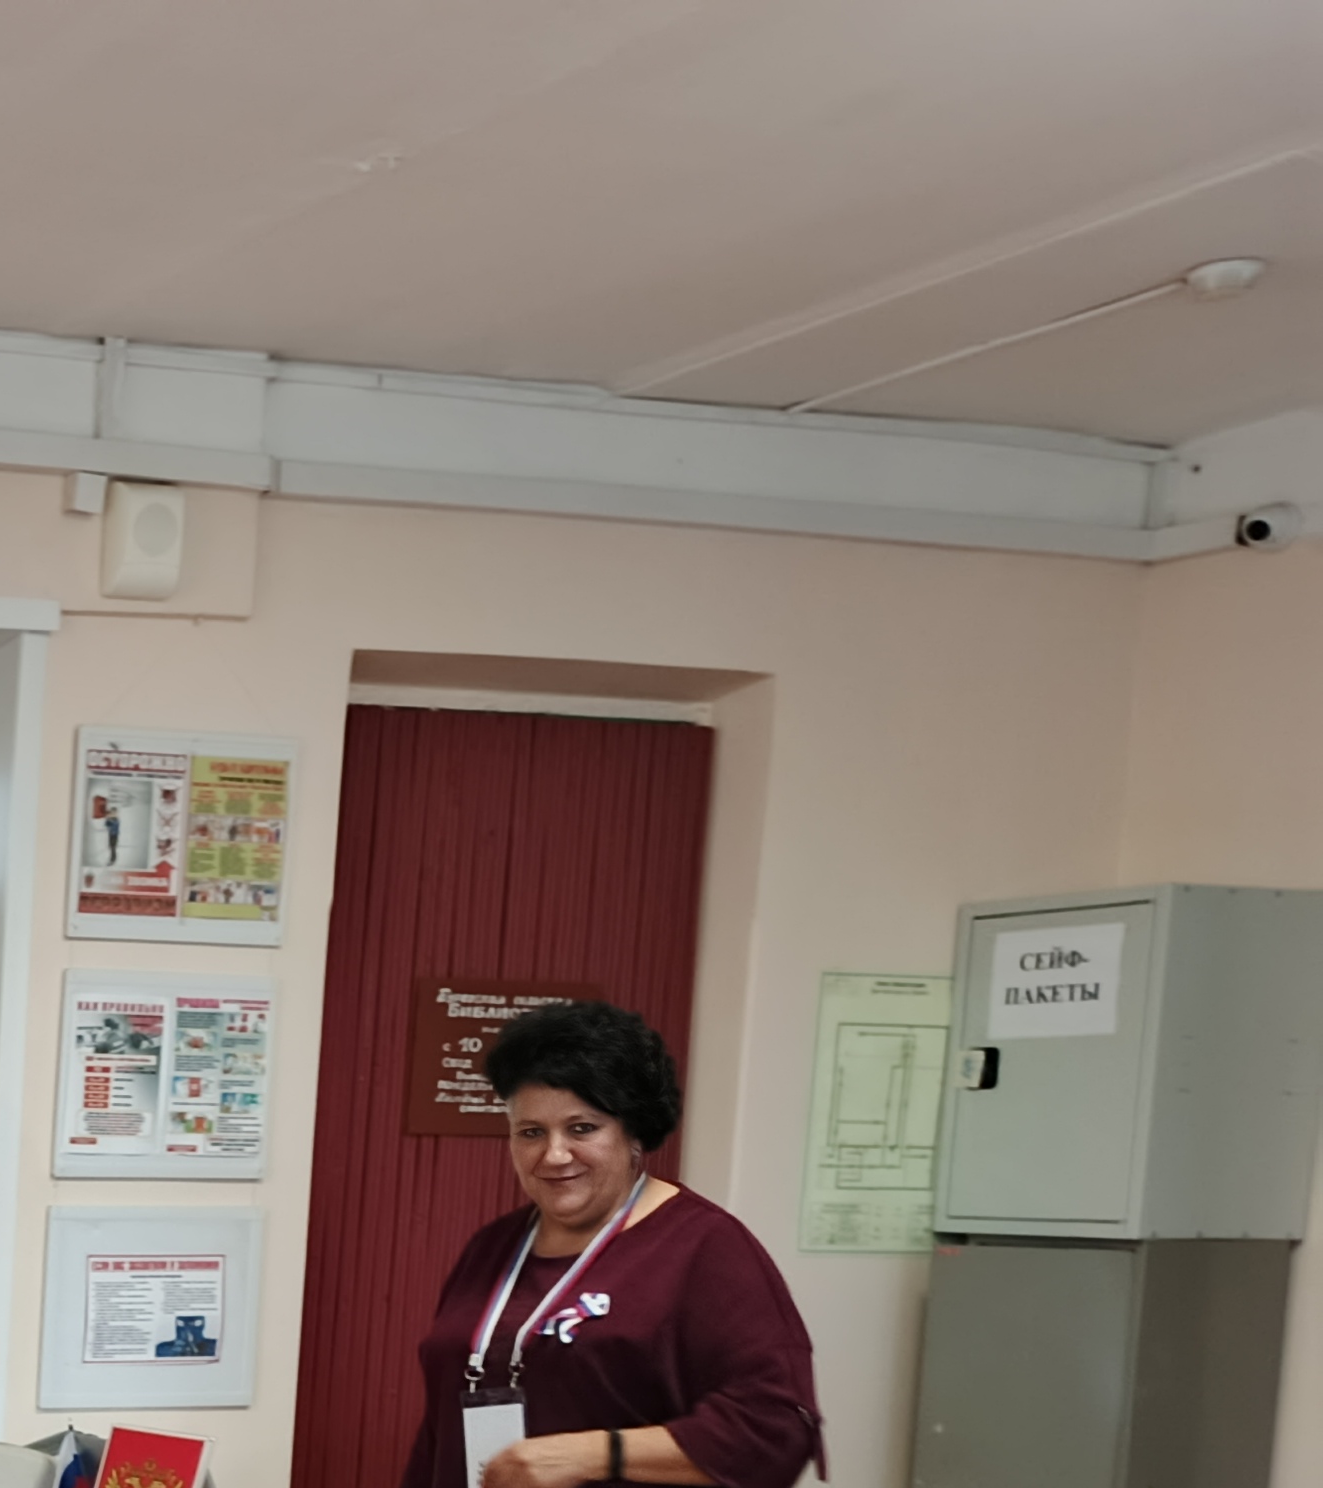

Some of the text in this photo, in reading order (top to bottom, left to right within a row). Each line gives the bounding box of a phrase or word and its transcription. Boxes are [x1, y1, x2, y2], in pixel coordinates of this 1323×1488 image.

[88, 751, 186, 772] ОСТОРОЖНО
[1019, 946, 1091, 972] СЕЙФ-
[1004, 982, 1101, 1006] ПАКЕТЫ
[458, 1037, 483, 1053] 10
